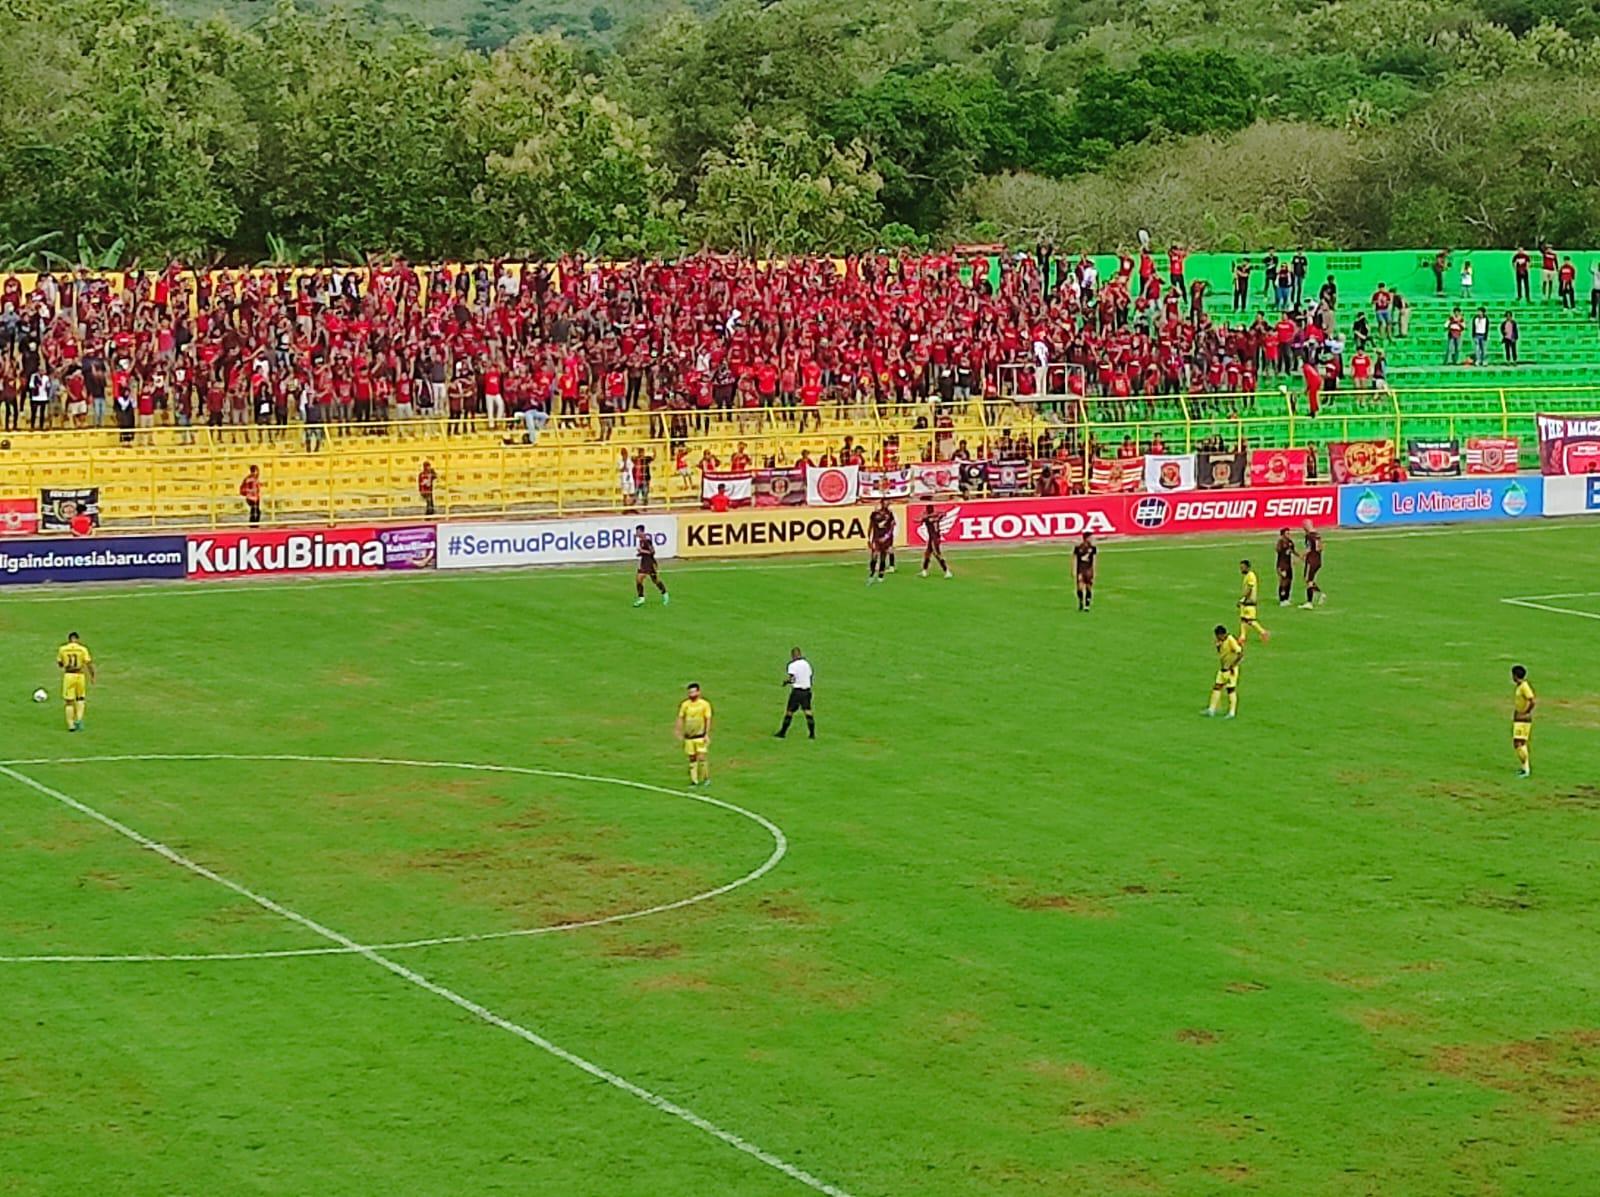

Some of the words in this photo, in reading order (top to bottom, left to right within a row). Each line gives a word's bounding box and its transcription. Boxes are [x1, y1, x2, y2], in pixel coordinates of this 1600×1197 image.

[1175, 500, 1257, 521] BOSOWA
[1264, 496, 1333, 517] SEMEN
[1392, 491, 1414, 515] Le
[687, 518, 865, 546] KEMENPORA
[959, 511, 1116, 540] HONDA
[187, 534, 385, 573] KukuBima
